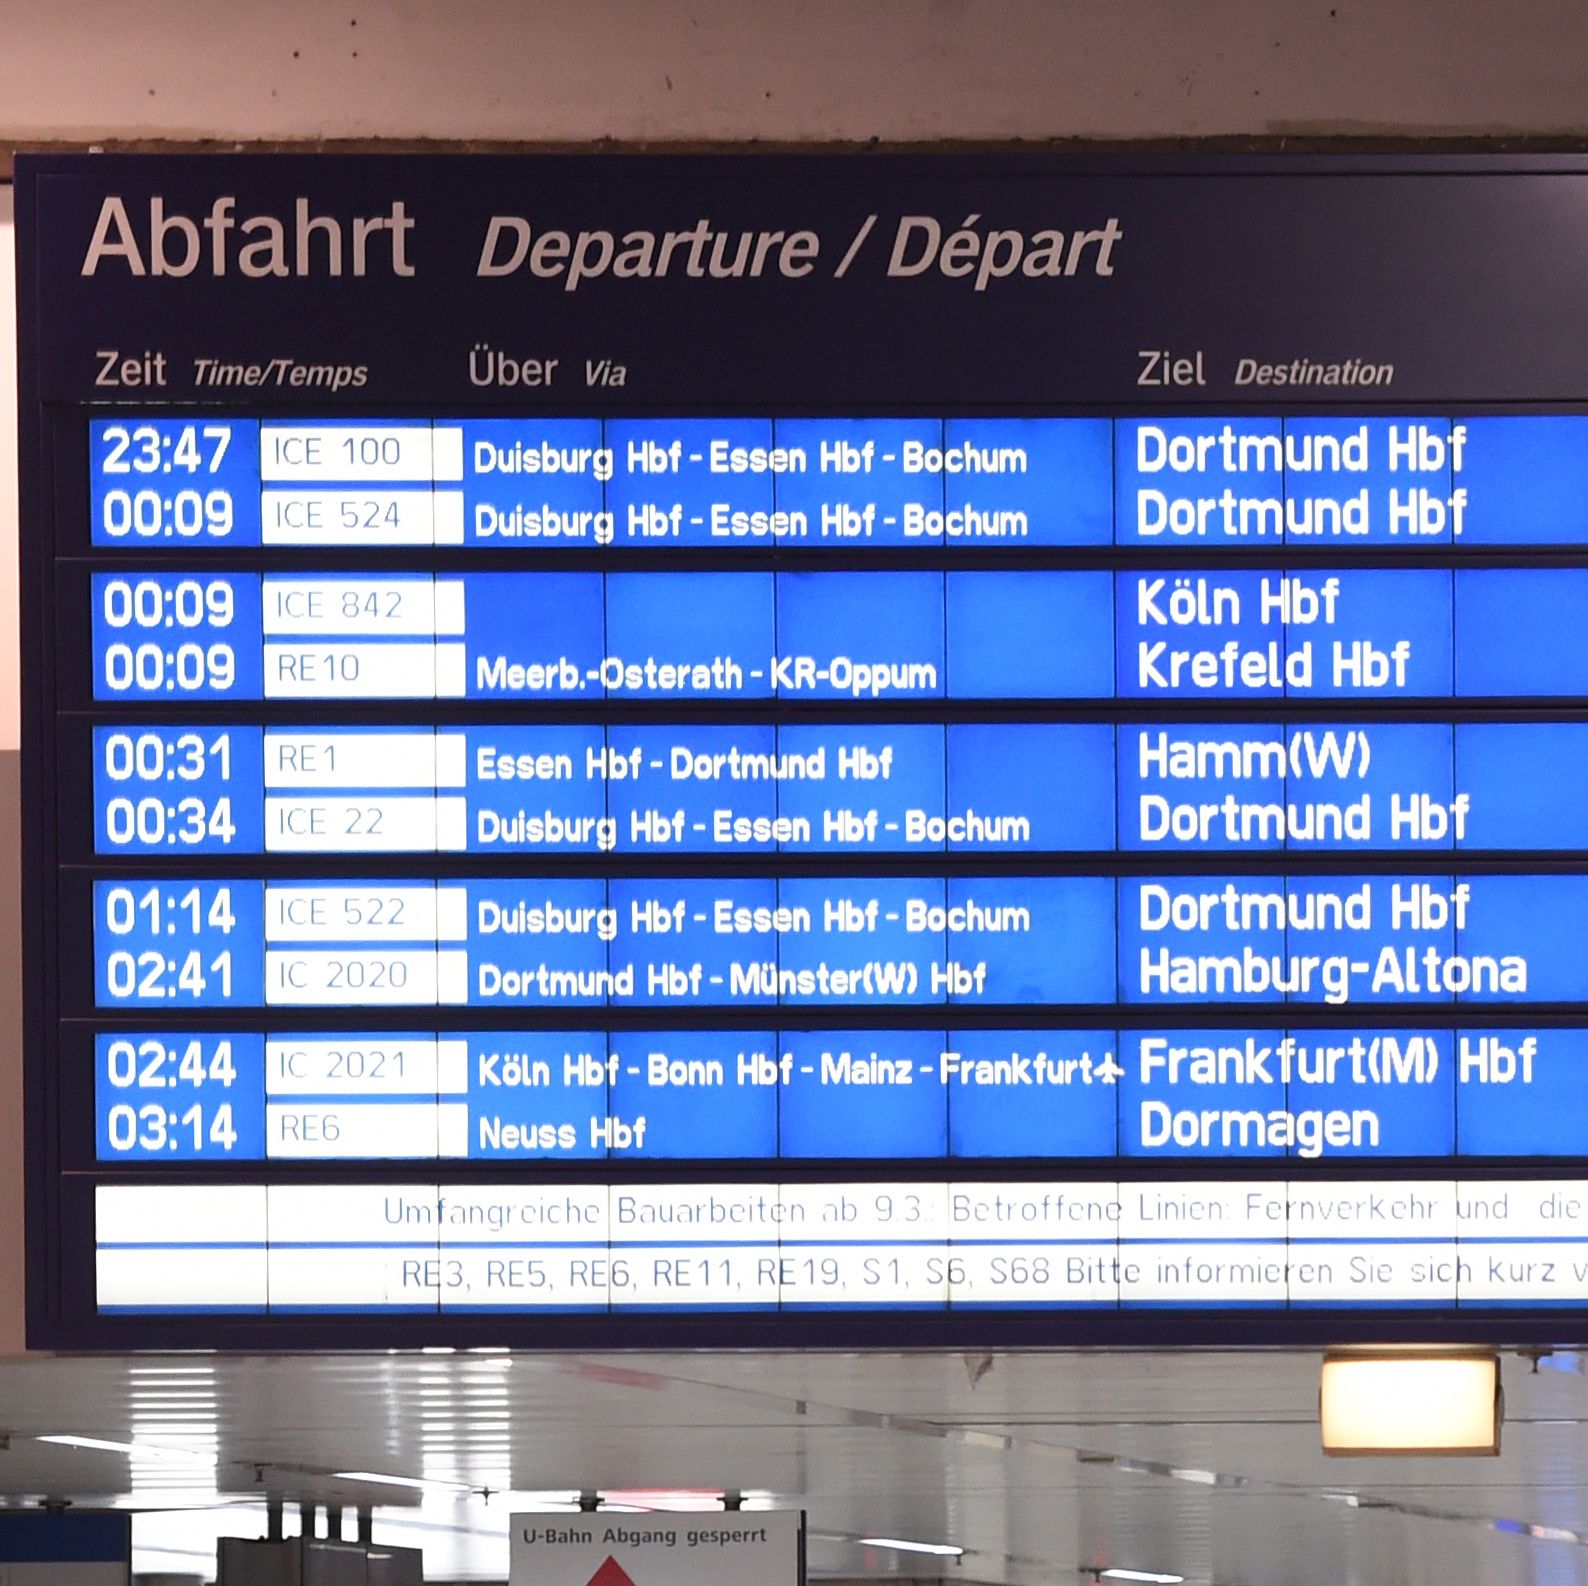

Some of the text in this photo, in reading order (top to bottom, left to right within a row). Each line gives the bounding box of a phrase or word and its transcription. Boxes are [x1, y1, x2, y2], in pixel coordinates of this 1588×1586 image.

[82, 197, 414, 277] Abfahrt
[477, 217, 819, 291] Departure
[887, 214, 1122, 290] Départ
[96, 351, 166, 386] Zeit
[195, 360, 367, 391] Time/Temps
[470, 344, 558, 386] Über
[587, 361, 626, 386] Via
[1138, 351, 1205, 385] Ziel
[1235, 359, 1393, 385] Destination
[103, 426, 1466, 472] 23:47 ICE 100 Dortmund Hbf
[104, 490, 233, 536] 00:09
[277, 502, 321, 528] ICE
[341, 502, 399, 528] 524
[1138, 489, 1369, 535] Dortmund
[1390, 488, 1467, 534] Hbf
[105, 581, 233, 627] 00:09
[278, 592, 322, 617] ICE
[342, 592, 401, 617] 842
[1139, 579, 1239, 624] Köln
[1261, 578, 1339, 624] Hbf
[106, 644, 234, 689] 00:09
[279, 655, 358, 681] RE10
[1139, 642, 1312, 687] Krefeld
[1333, 641, 1410, 687] Hbf
[106, 735, 232, 780] 00:31
[1140, 732, 1370, 780] Hamm(W)
[107, 798, 235, 843] 00:34
[1140, 794, 1370, 840] Dortmund
[1391, 794, 1469, 839] Hbf
[107, 888, 235, 934] 01:14
[1141, 884, 1370, 930] Dortmund
[1392, 884, 1470, 929] Hbf
[108, 951, 232, 997] 02:41
[1141, 947, 1527, 1003] Hamburg-Altona
[108, 1041, 236, 1087] 02:44
[1141, 1037, 1438, 1084] Frankfurt(M)
[1460, 1037, 1536, 1083] Hbf
[109, 1104, 237, 1150] 03:14
[479, 1117, 576, 1149] Neuss
[591, 1117, 645, 1148] Hbf
[1141, 1101, 1379, 1157] Dormagen
[523, 1528, 767, 1547] U-Bahn Abgang gesperrt
